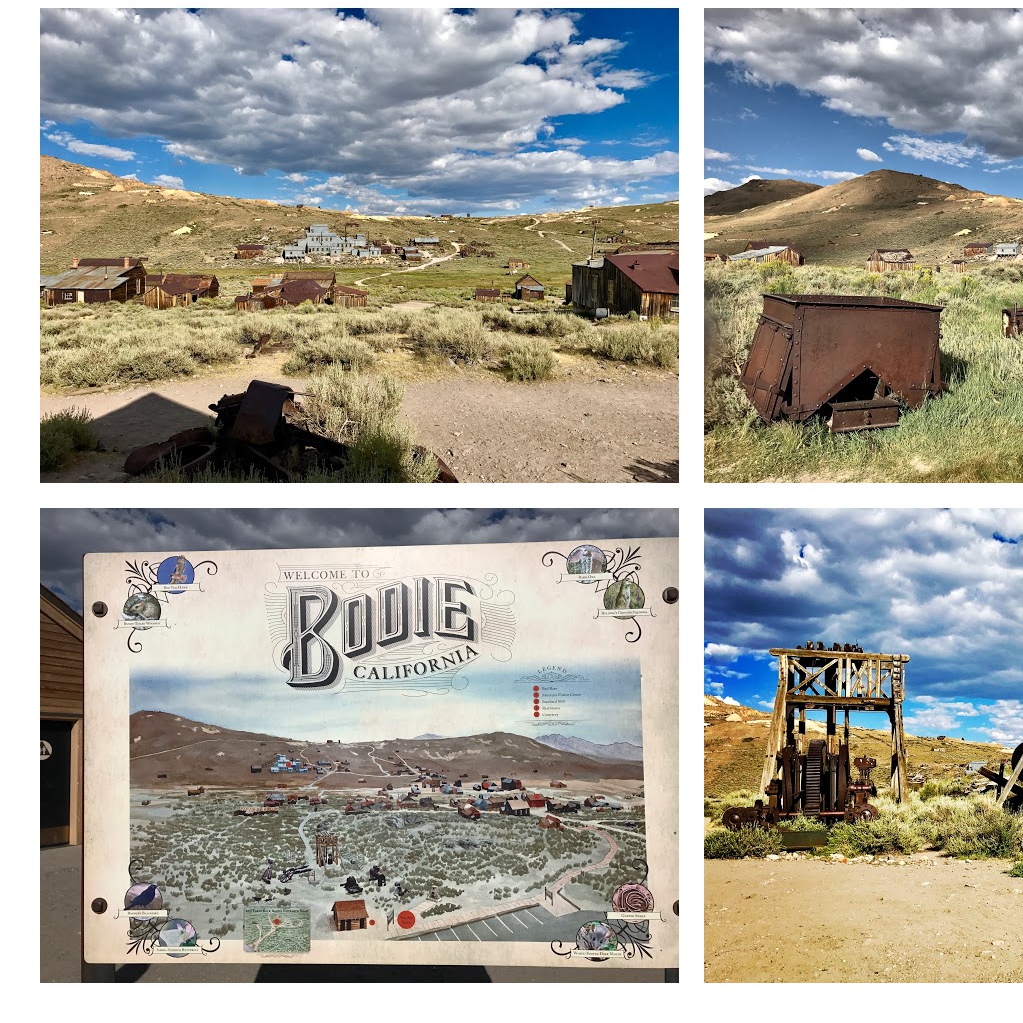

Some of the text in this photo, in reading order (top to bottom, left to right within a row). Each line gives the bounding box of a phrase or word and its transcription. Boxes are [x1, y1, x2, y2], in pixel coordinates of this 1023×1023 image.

[284, 569, 369, 580] WELCOME TO
[282, 577, 478, 691] BODIE
[353, 645, 479, 680] CALIFORNIA
[538, 665, 567, 673] LEGEND
